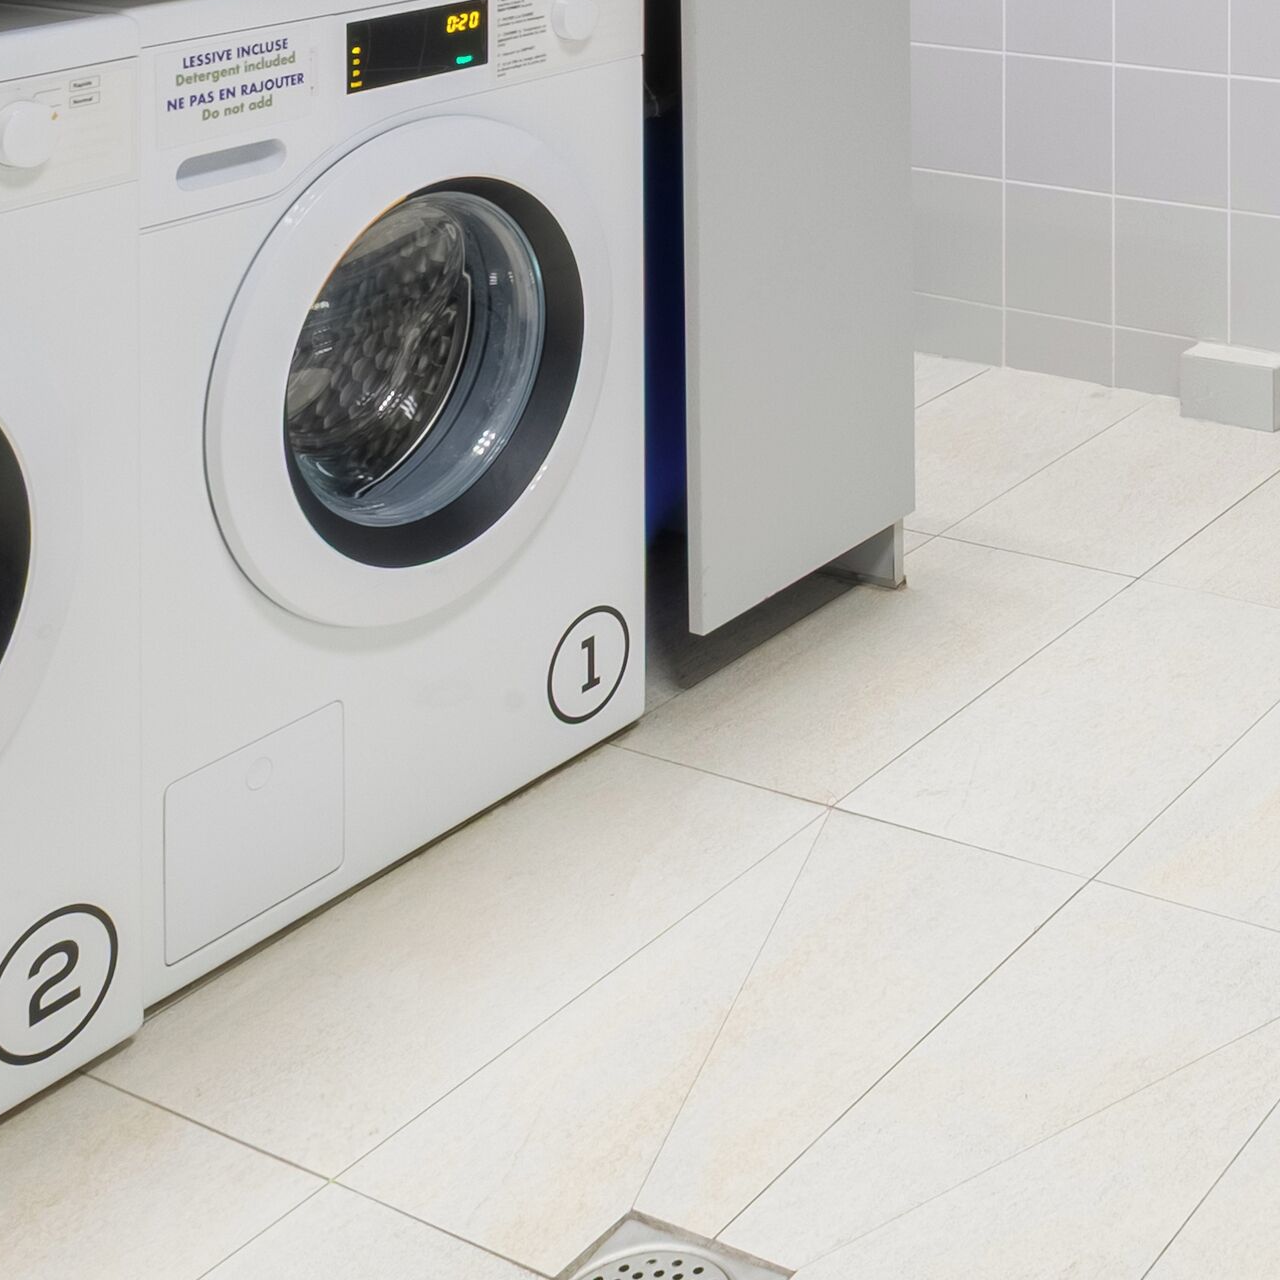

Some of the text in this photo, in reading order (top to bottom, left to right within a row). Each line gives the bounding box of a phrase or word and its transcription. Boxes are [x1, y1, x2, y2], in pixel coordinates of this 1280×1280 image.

[446, 11, 480, 34] 0:20
[175, 51, 296, 87] Detergent included
[183, 38, 289, 69] LESSIVE INCLUSE
[167, 72, 305, 112] NE PAS EN RAJOUTER
[201, 94, 273, 121] Do not add
[580, 635, 602, 696] 1
[26, 938, 82, 1028] 2
